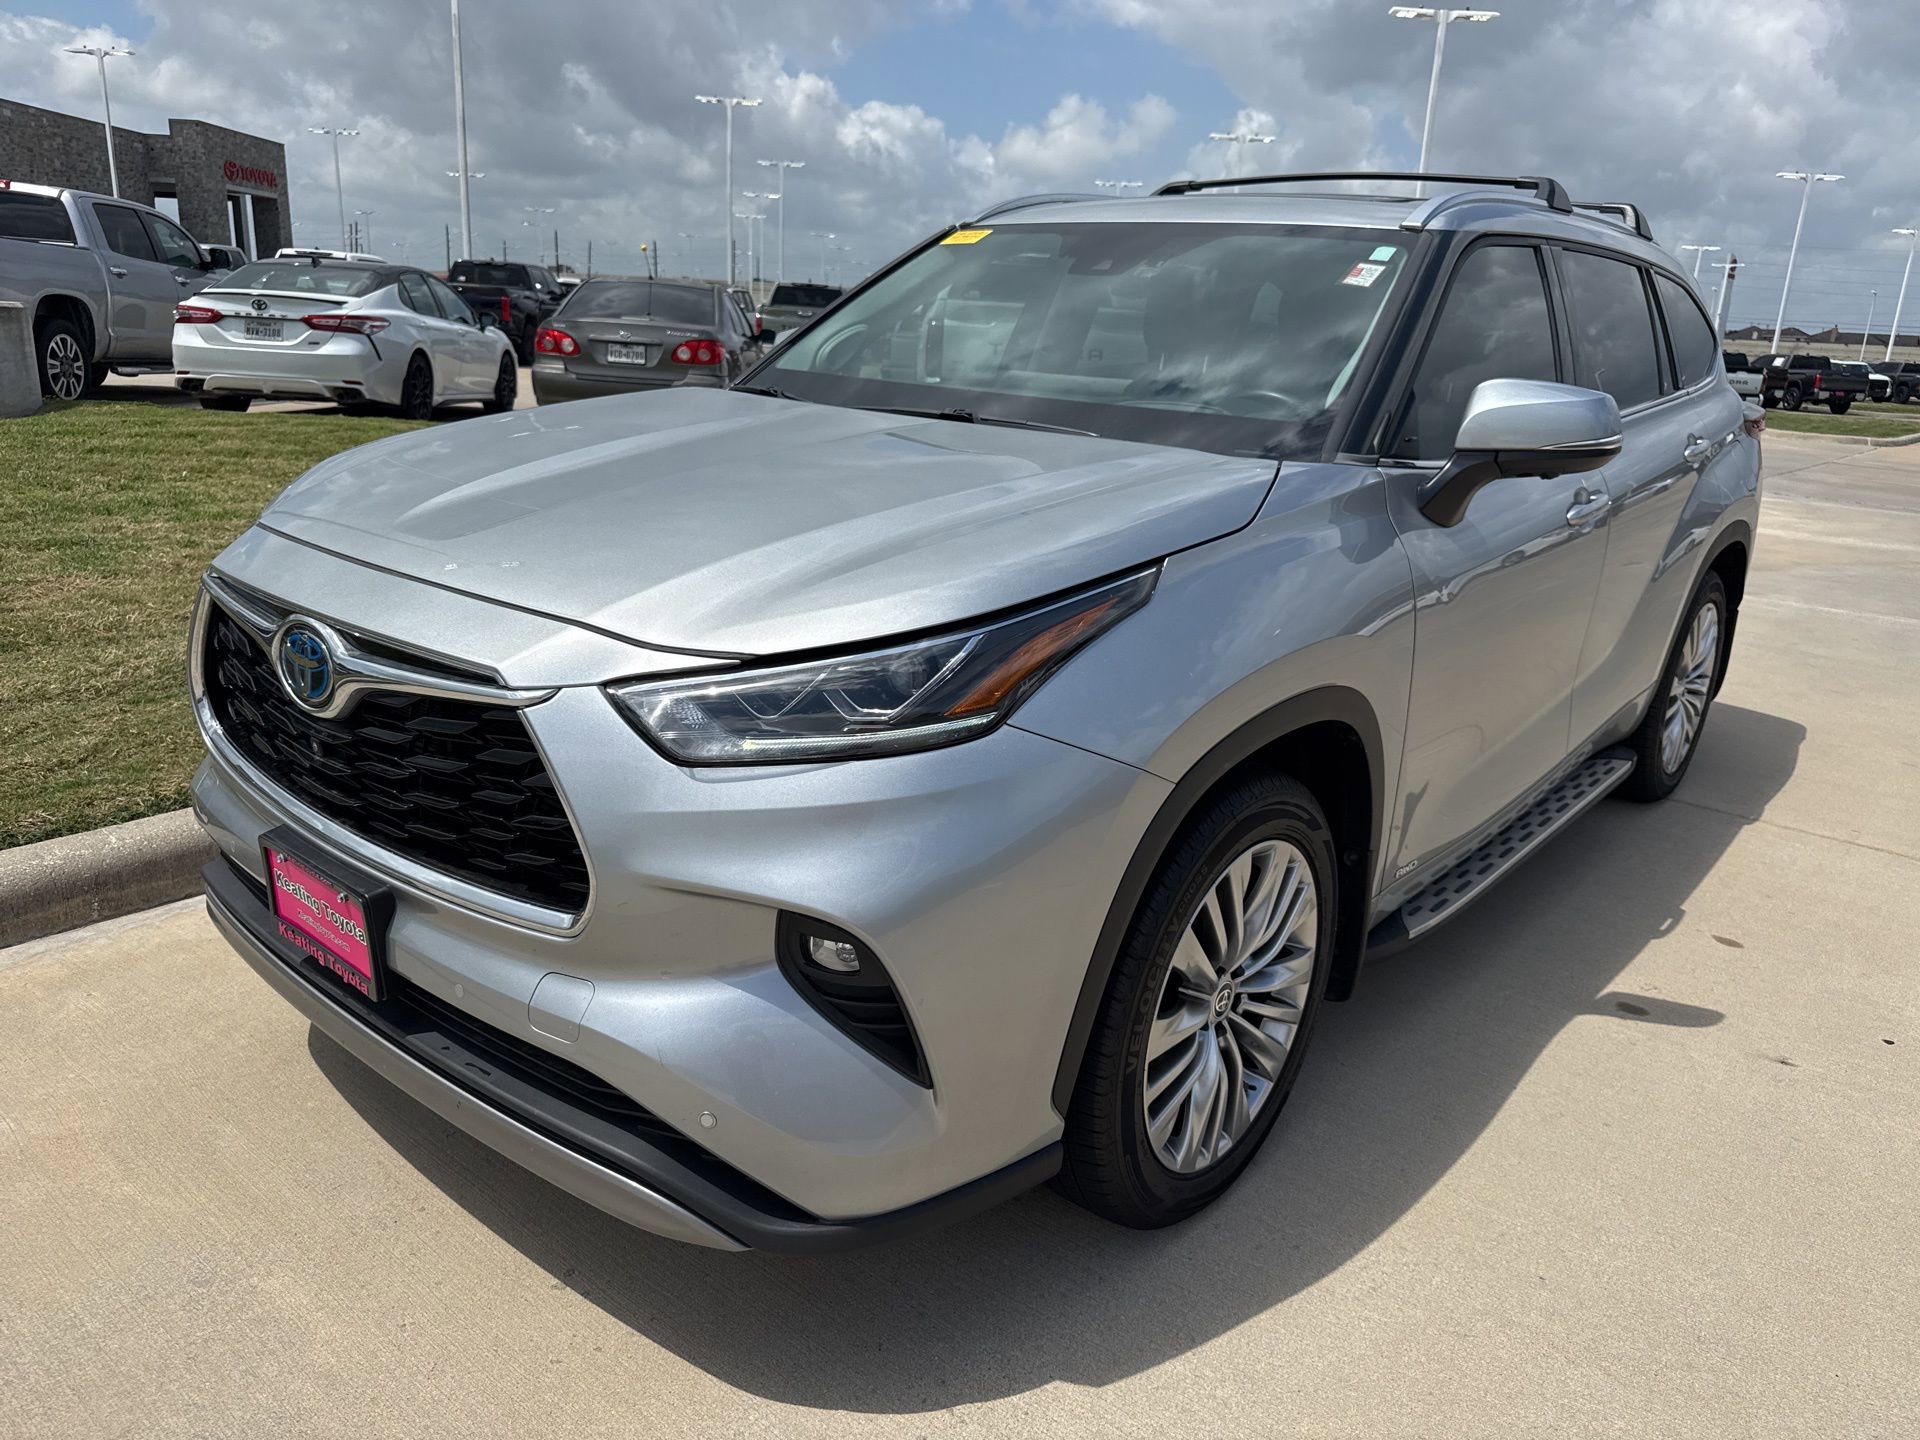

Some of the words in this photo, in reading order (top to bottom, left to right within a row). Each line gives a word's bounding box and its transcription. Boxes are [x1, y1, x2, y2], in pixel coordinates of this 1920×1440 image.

[239, 166, 278, 189] TOYOTA
[273, 868, 321, 918] Keating
[321, 900, 367, 945] Toyota
[278, 921, 325, 967] Keating
[325, 956, 369, 996] Toyota
[1125, 917, 1180, 1075] VELOCITY
